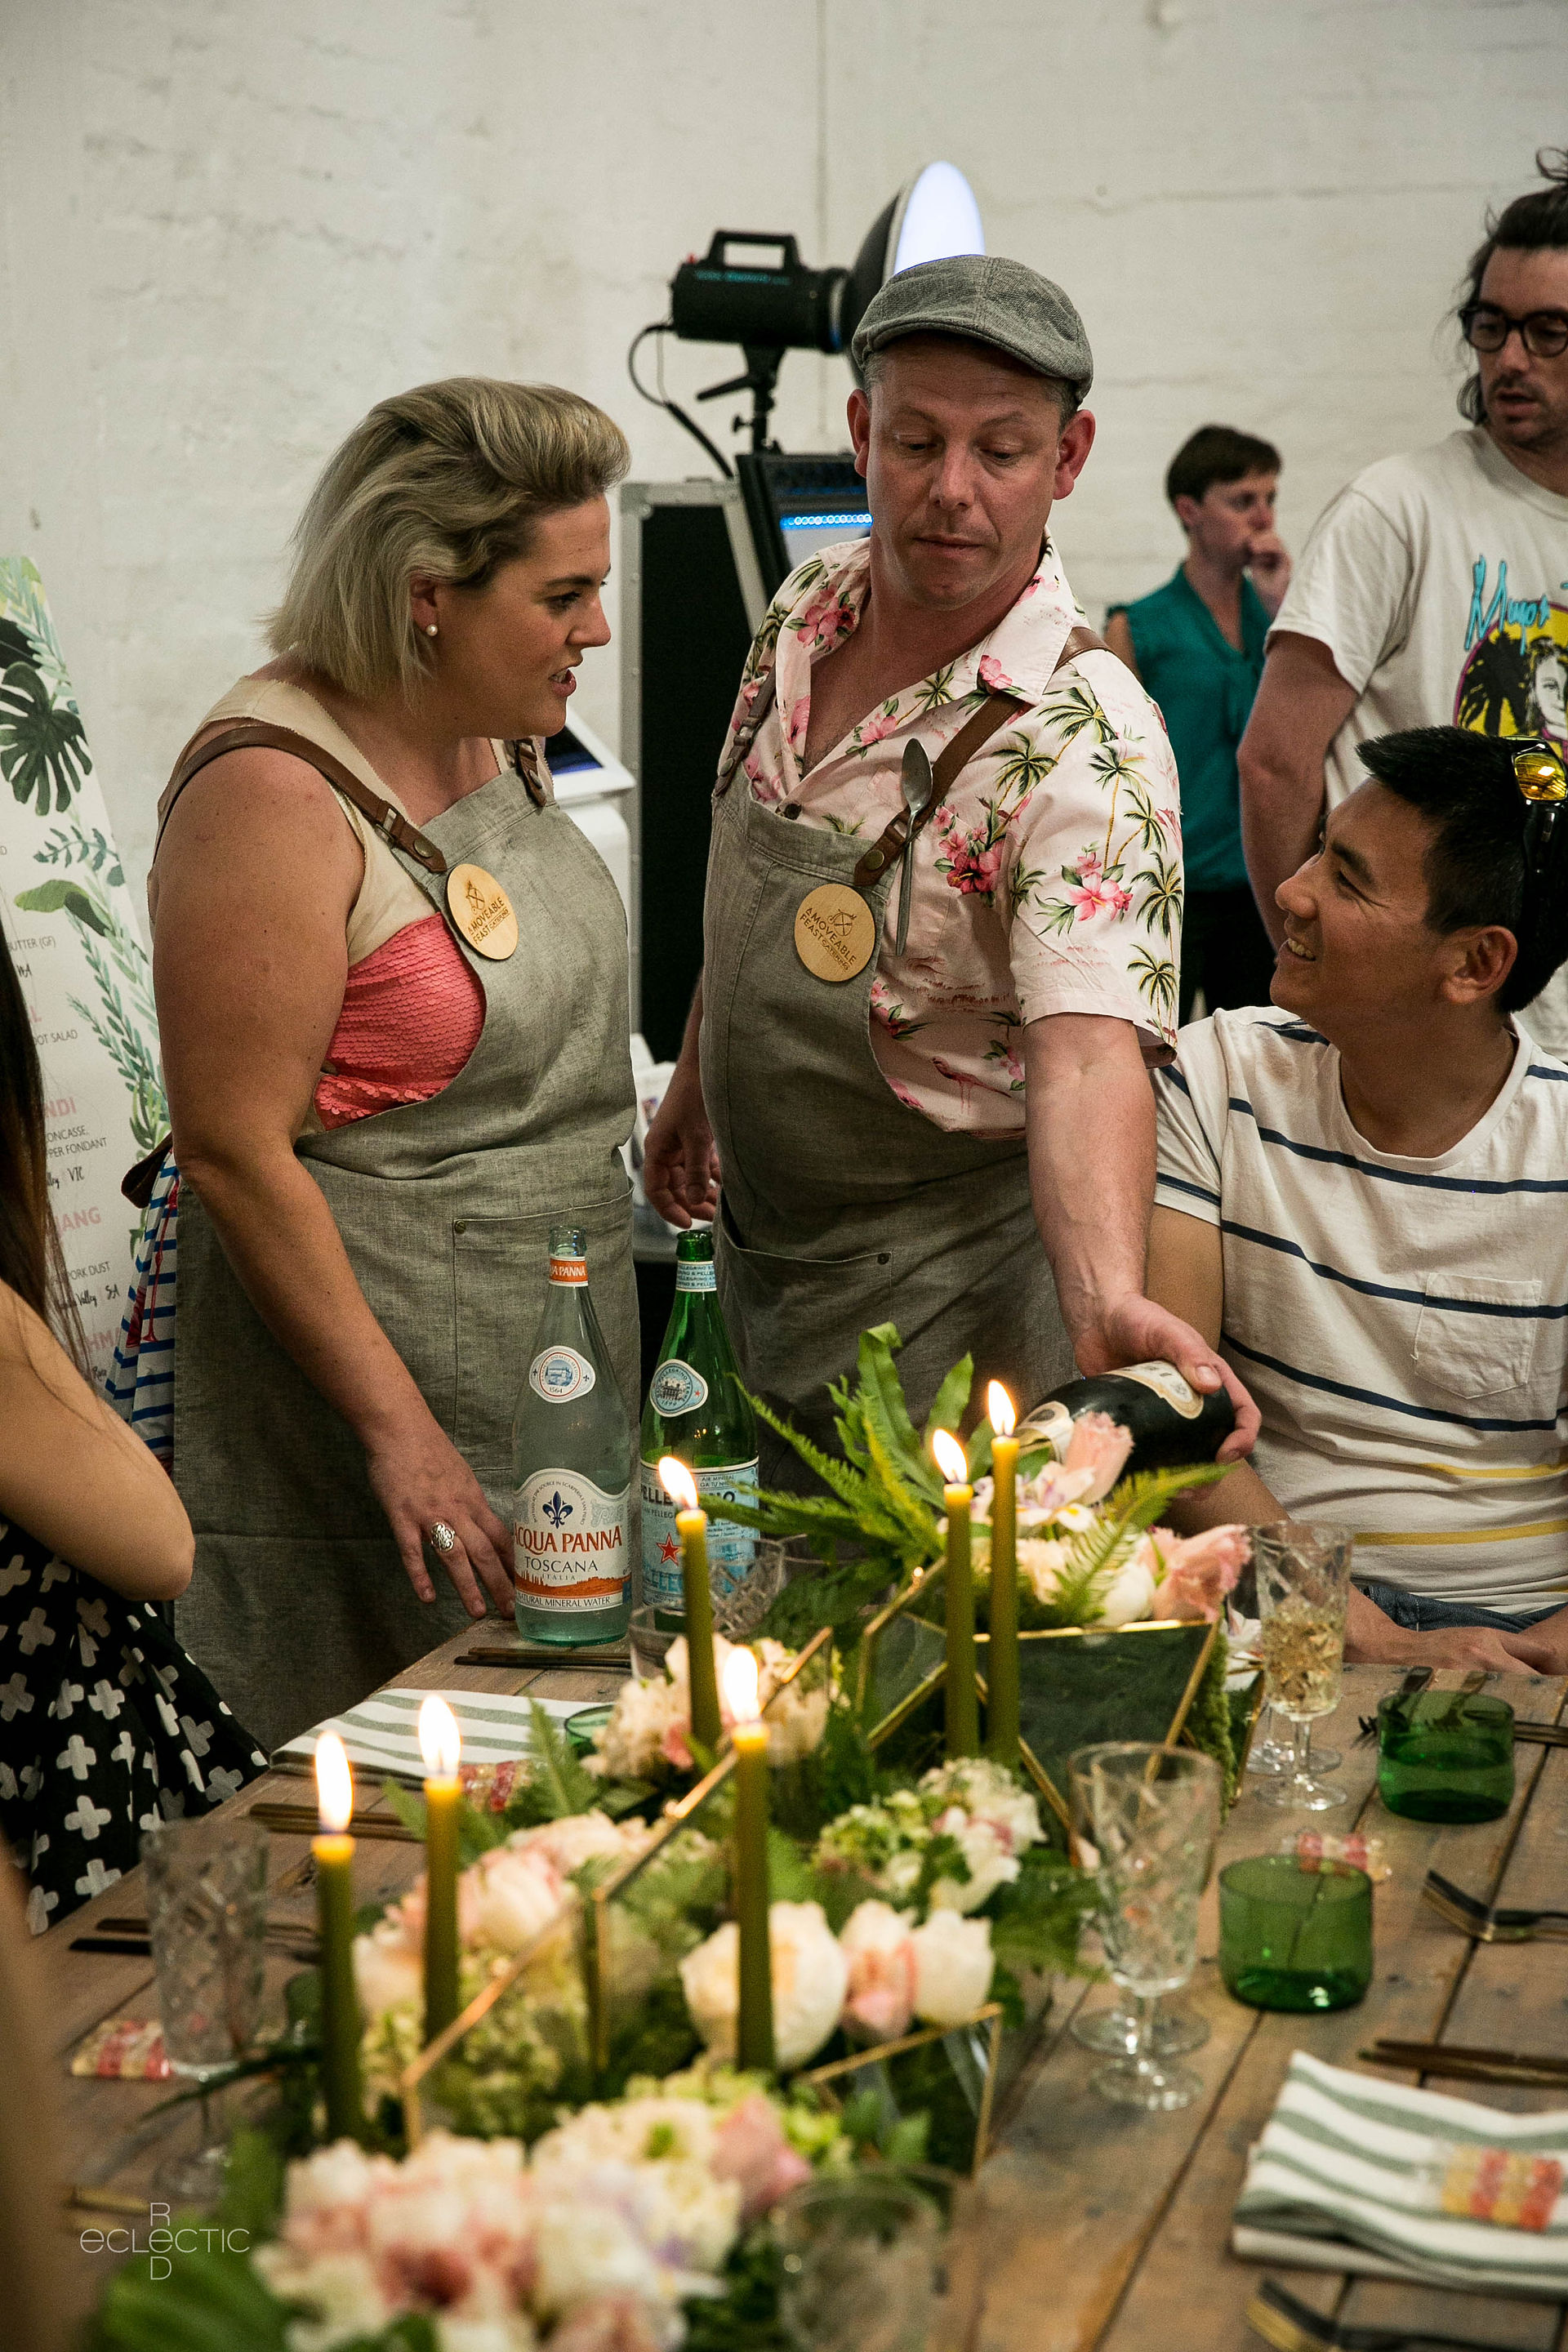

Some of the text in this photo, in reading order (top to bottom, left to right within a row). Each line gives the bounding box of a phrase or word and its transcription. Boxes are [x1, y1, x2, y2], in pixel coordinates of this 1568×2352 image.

[470, 897, 505, 932] MOVEABLE
[473, 924, 492, 945] FEAST
[800, 914, 823, 940] FEAST
[811, 913, 857, 965] MOVEABLE
[50, 1029, 78, 1043] SALAD
[45, 1097, 77, 1118] NDI
[65, 1137, 107, 1155] FONDANT
[87, 1261, 111, 1276] DUST
[559, 1265, 586, 1276] PANNA
[513, 1521, 558, 1556] ACQUA
[561, 1526, 623, 1552] PANNA
[524, 1556, 598, 1573] TOSCANA
[517, 1592, 611, 1607] NATURAL MINERAL WATER
